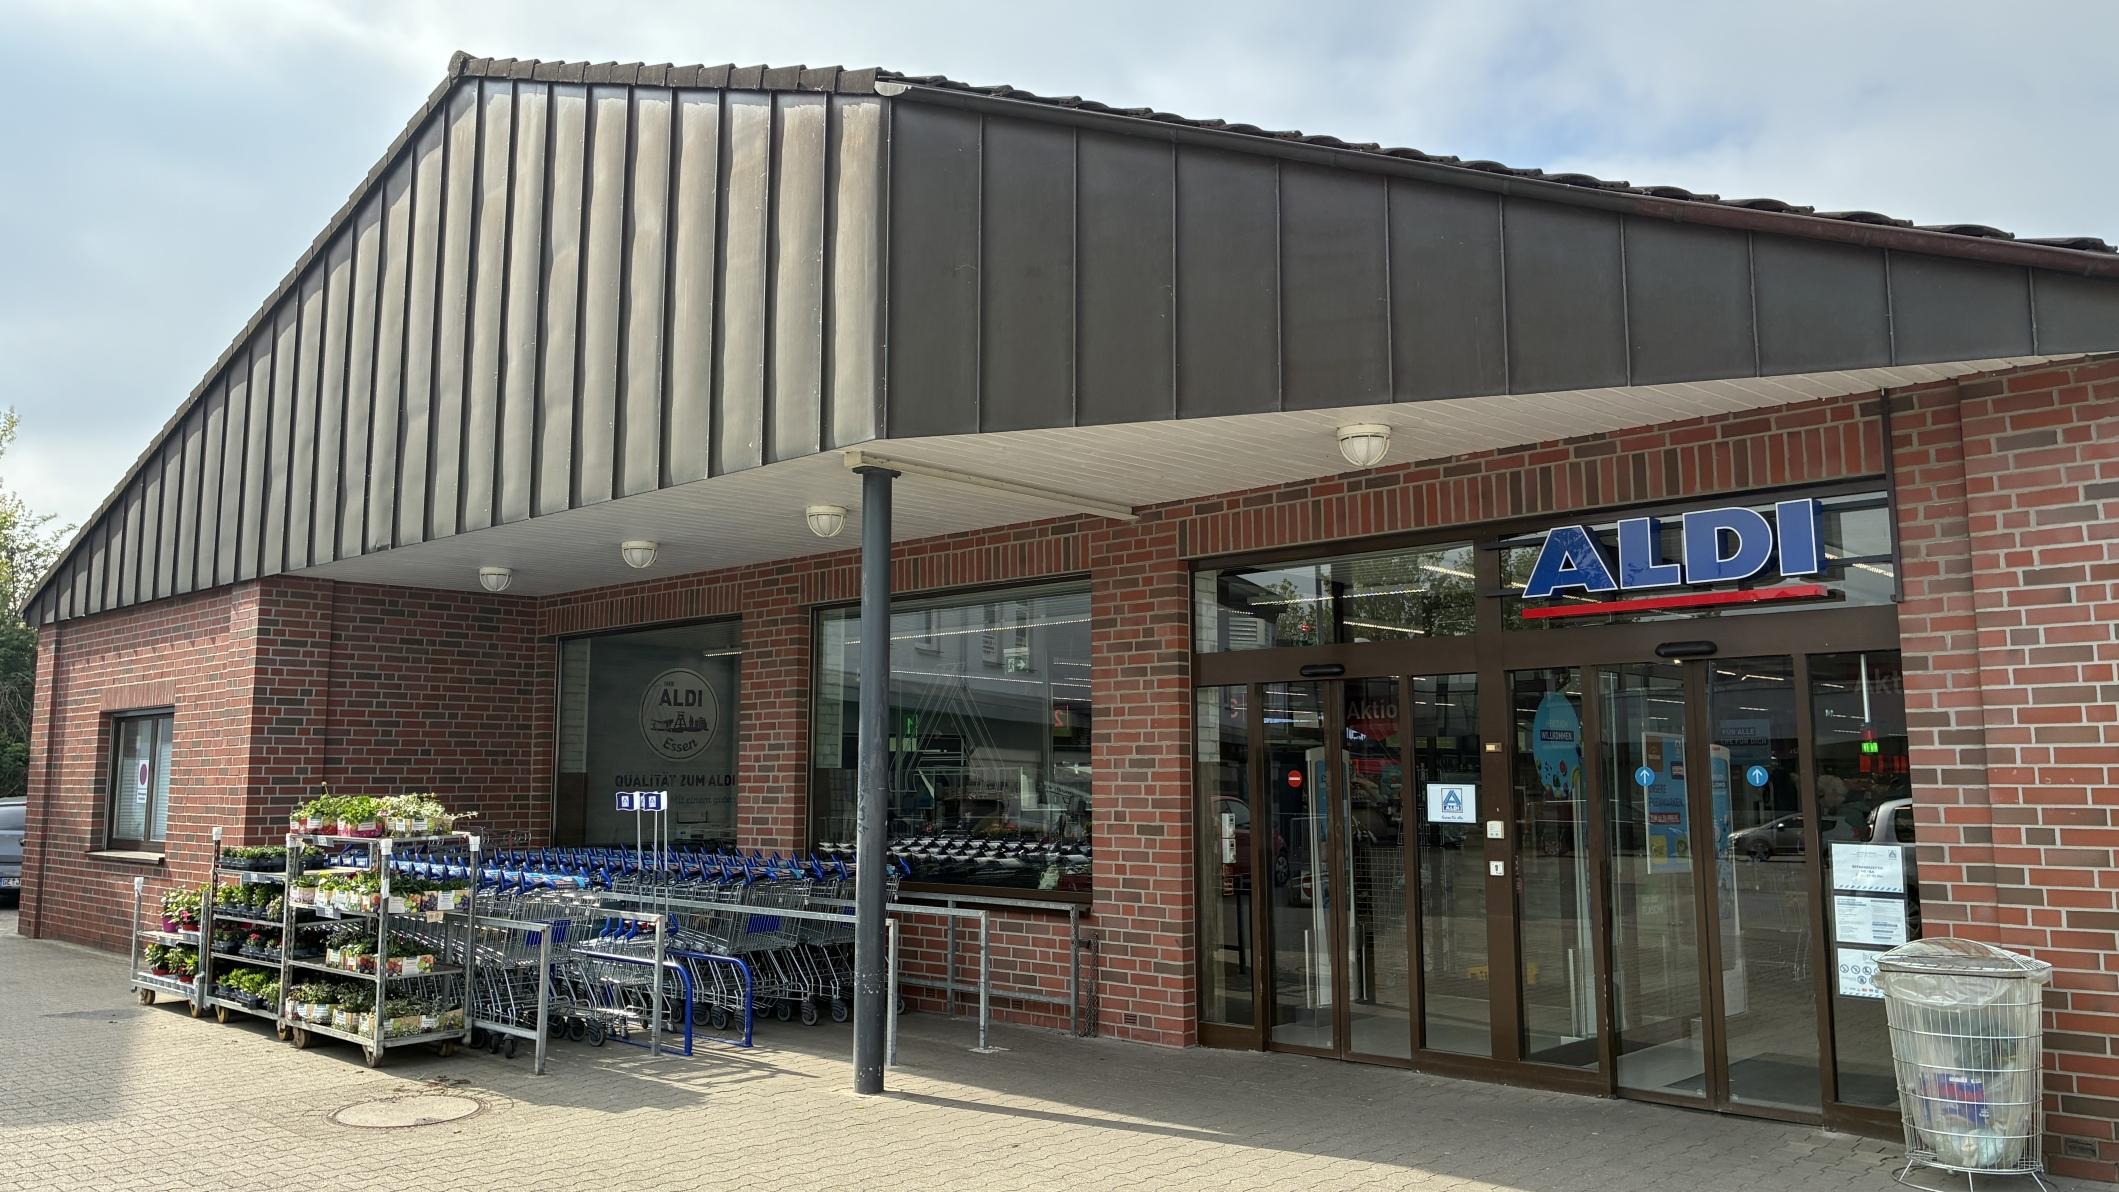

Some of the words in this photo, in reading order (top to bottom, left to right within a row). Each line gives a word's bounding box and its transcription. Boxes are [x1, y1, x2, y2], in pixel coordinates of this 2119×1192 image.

[1522, 498, 1819, 598] ALDI
[659, 688, 703, 707] ALDI
[663, 736, 698, 752] Essen
[615, 771, 677, 787] QUALITÄT
[680, 774, 705, 786] ZUM
